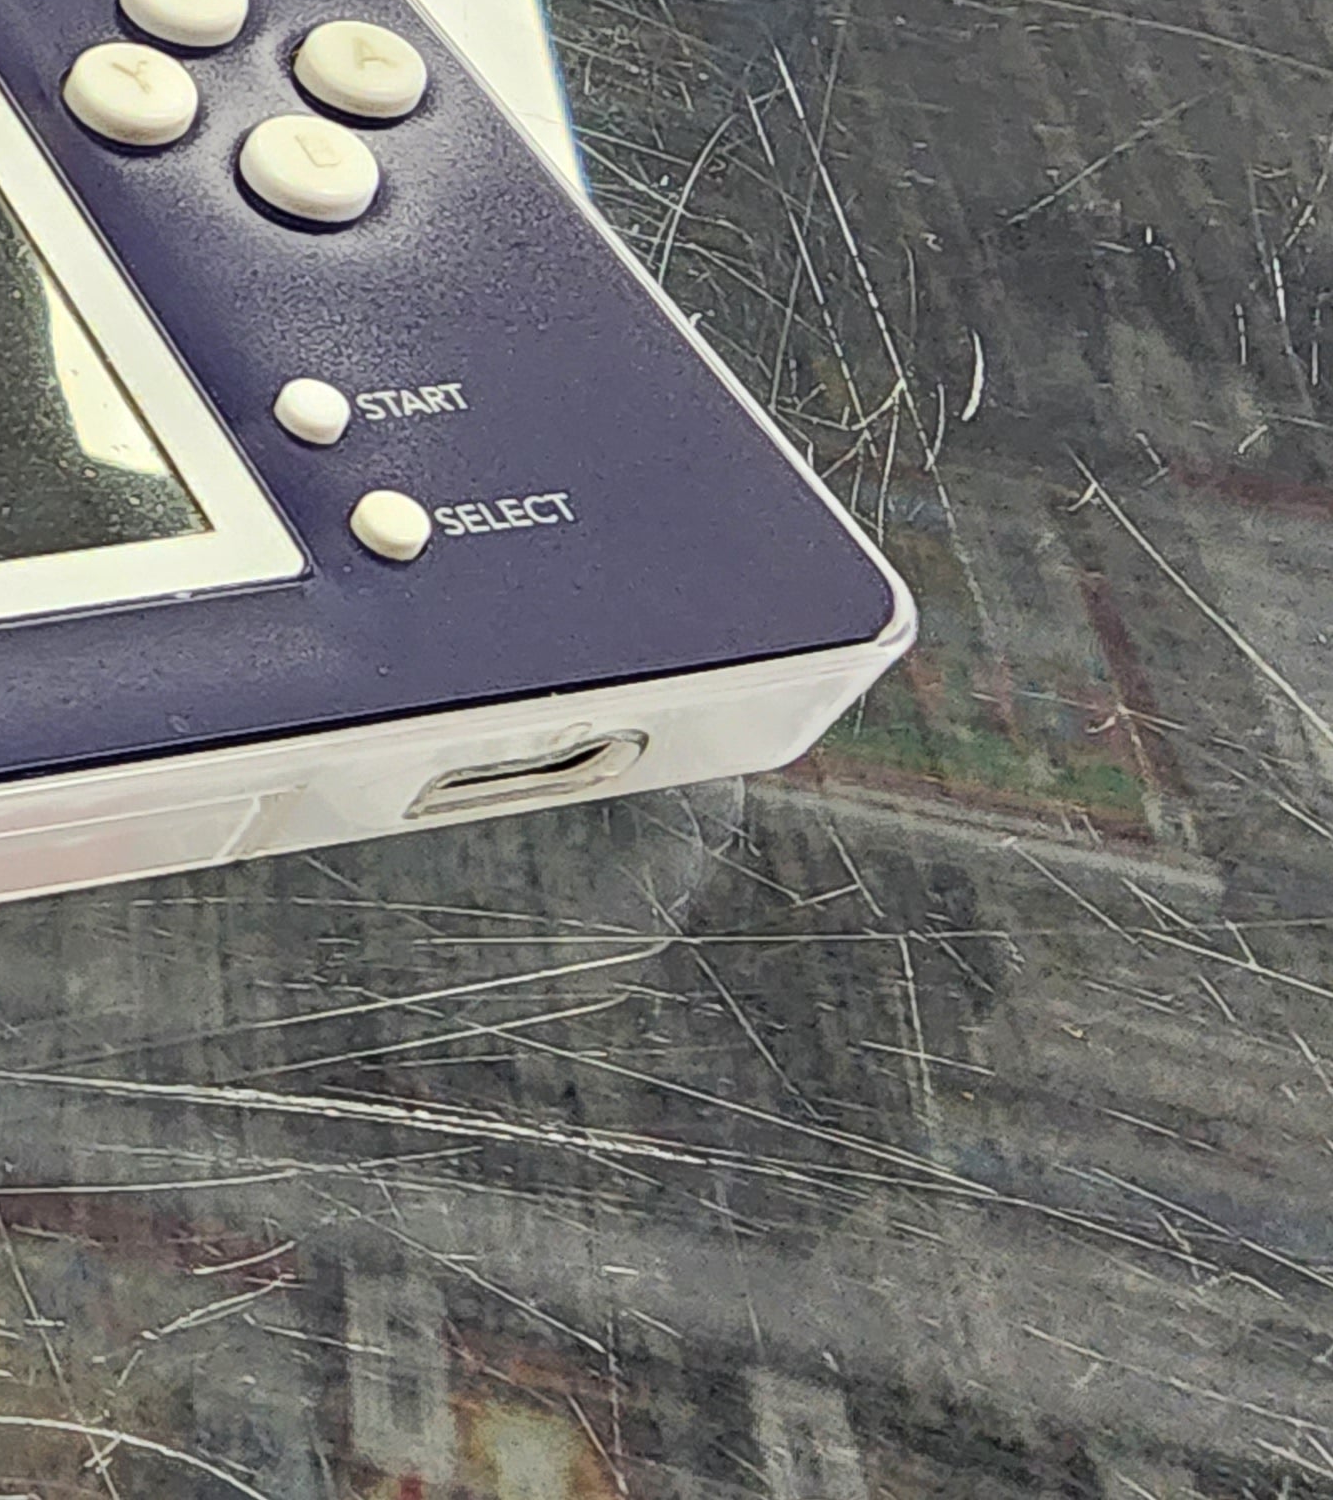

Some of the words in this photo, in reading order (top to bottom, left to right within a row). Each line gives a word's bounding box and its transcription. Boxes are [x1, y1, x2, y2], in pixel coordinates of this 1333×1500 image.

[352, 36, 399, 70] A
[110, 59, 154, 94] Y
[356, 383, 469, 421] START
[433, 493, 574, 536] SELECT
